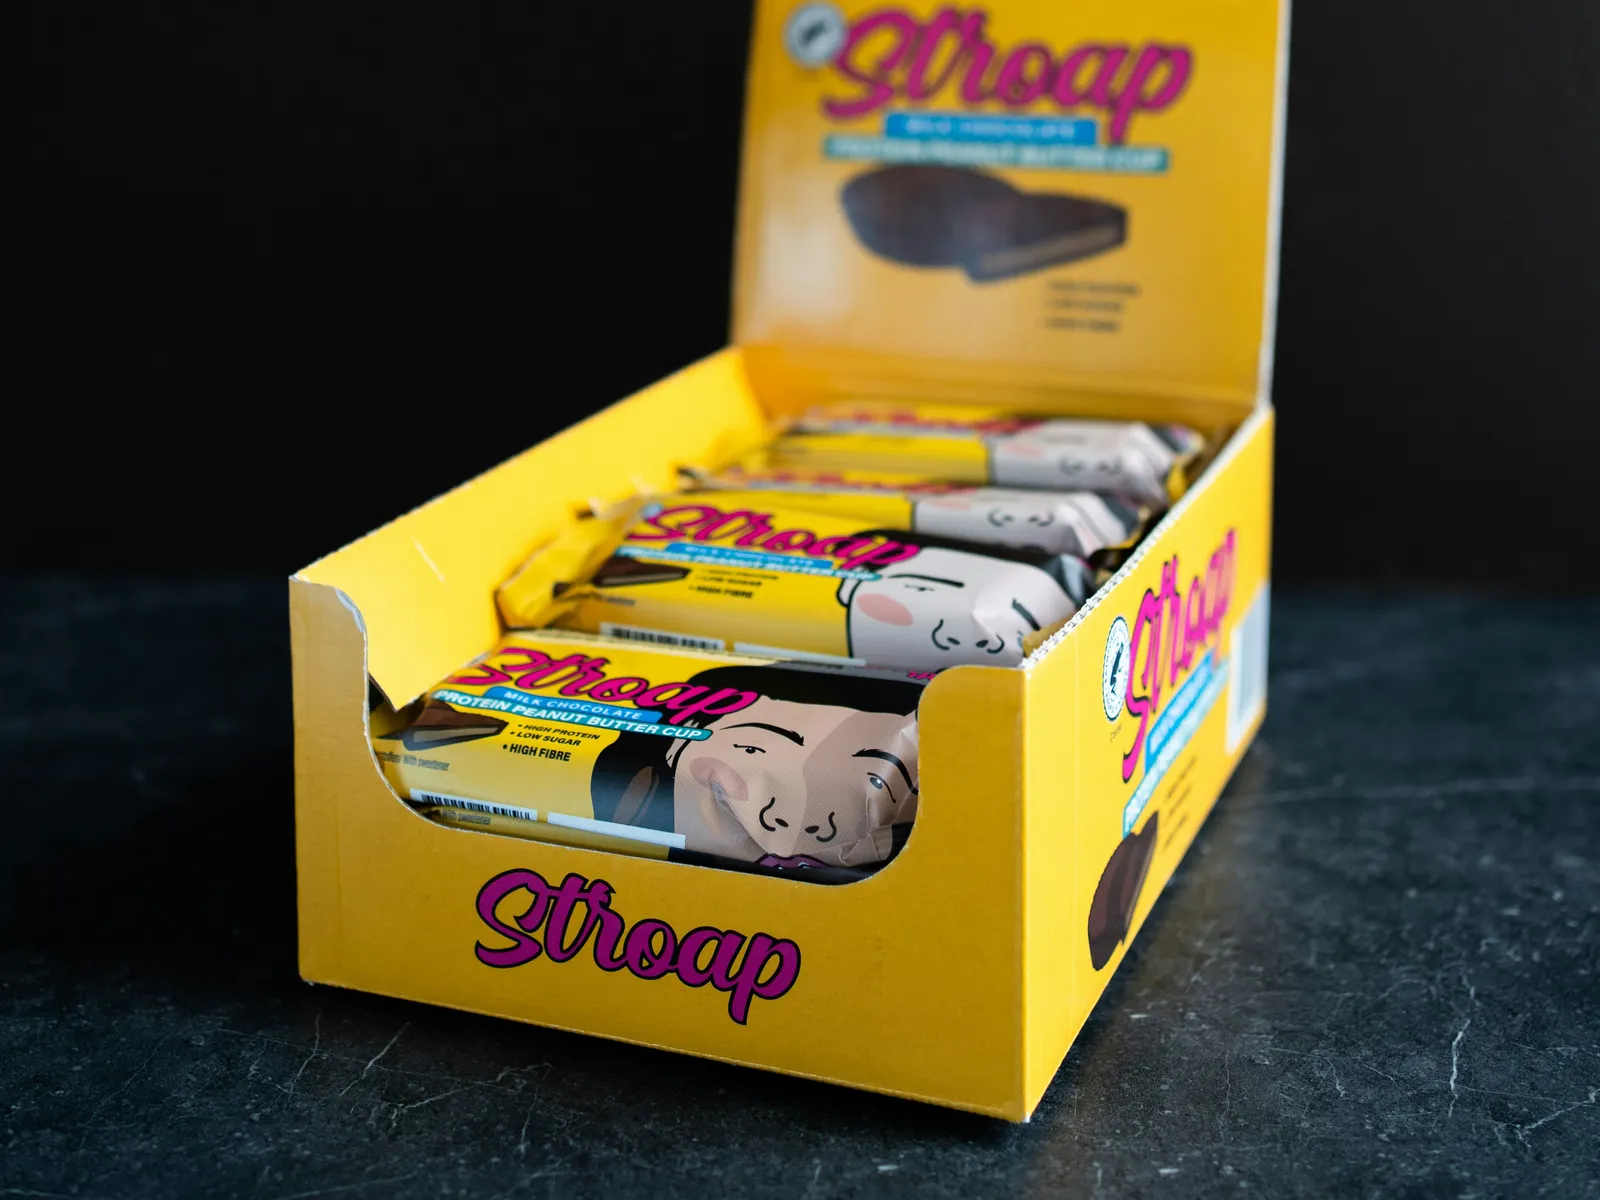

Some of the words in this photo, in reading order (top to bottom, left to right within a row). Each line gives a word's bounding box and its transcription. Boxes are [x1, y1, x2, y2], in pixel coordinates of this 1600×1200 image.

[818, 3, 1194, 146] Stroap
[624, 503, 921, 570] Stroap
[447, 647, 758, 725] Stroap
[503, 691, 541, 706] MILK
[546, 698, 643, 721] CHOCOLATE
[435, 689, 512, 711] PROTEIN
[515, 703, 587, 726] PEANUT
[587, 714, 660, 736] BUTTER
[661, 725, 702, 740] CUP
[517, 731, 541, 741] LOW
[542, 734, 581, 747] SUGAR
[523, 724, 549, 734] HIGH
[551, 726, 600, 741] PROTEIN
[509, 743, 538, 757] HIGH
[539, 747, 571, 762] FIBRE
[475, 867, 801, 1025] Stroap
